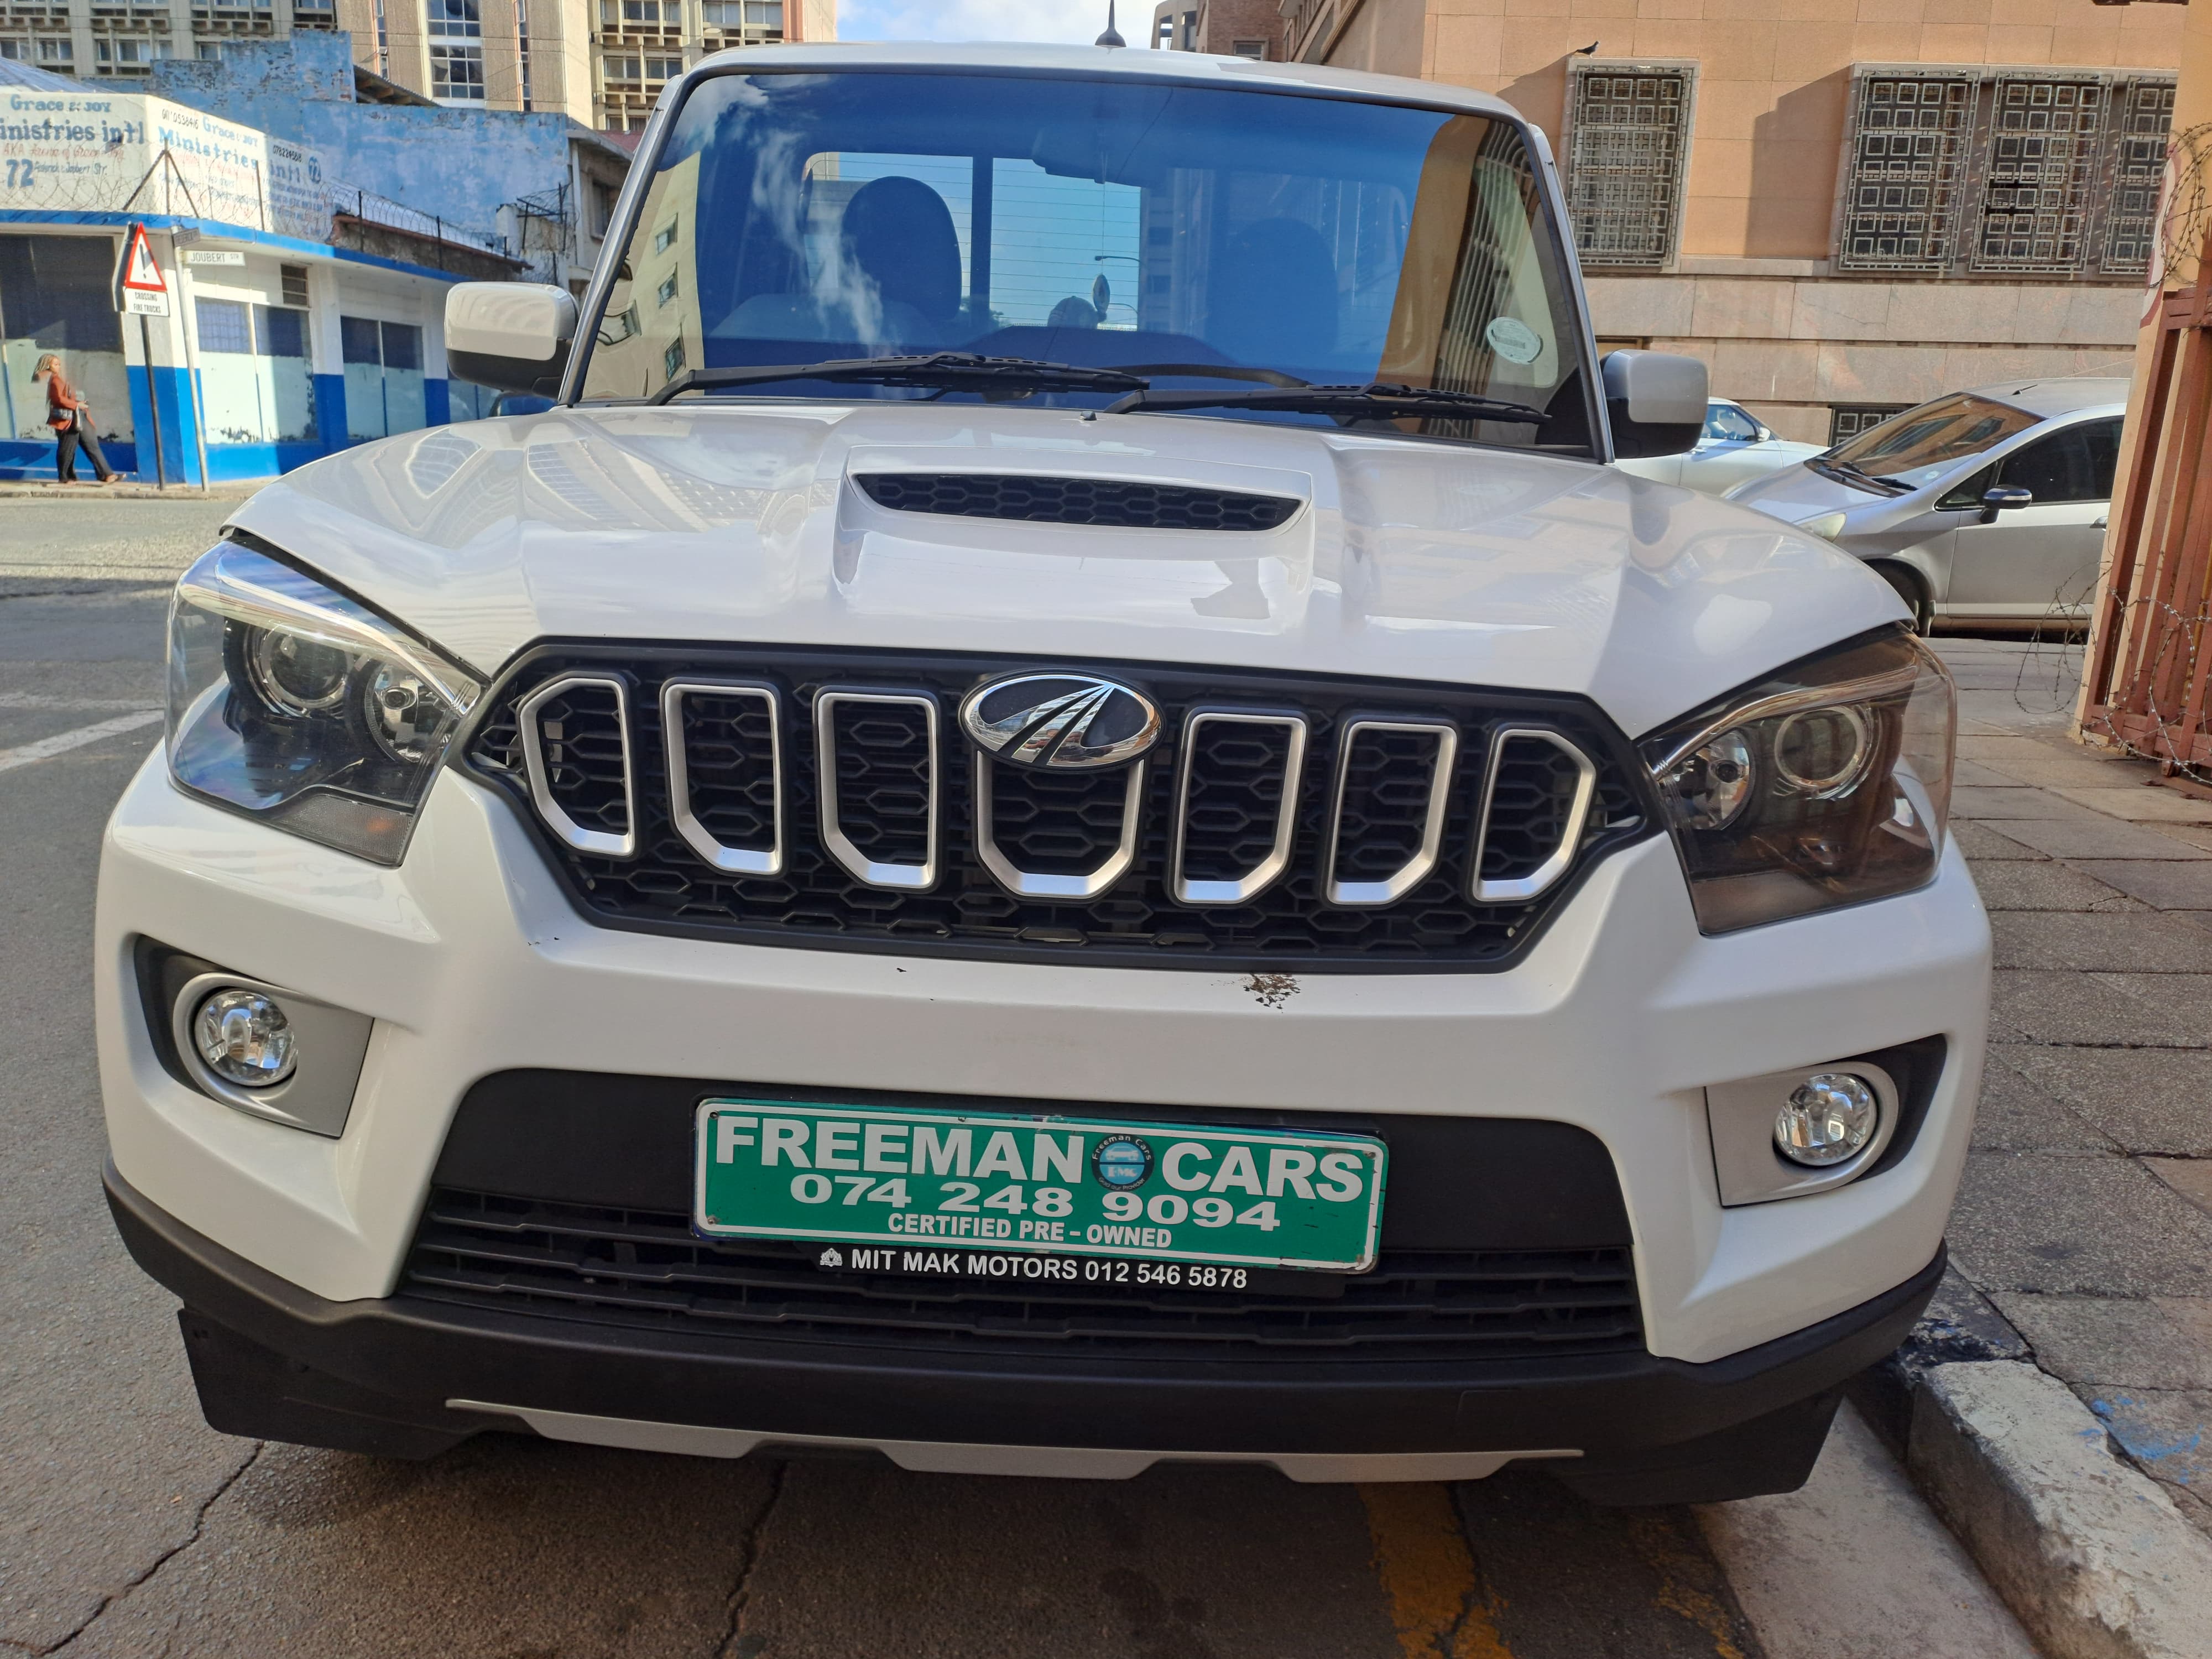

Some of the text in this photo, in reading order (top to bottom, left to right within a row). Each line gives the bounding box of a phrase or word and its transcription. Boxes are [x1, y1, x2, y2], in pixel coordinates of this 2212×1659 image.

[10, 94, 64, 112] Grace
[4, 143, 24, 156] AKA
[6, 158, 35, 189] 72
[191, 252, 225, 263] JOUBERT
[716, 1114, 1363, 1202] FREEMAN CARS
[1092, 1135, 1152, 1161] Freeman Cars
[790, 1173, 1281, 1232] 074 248 9094
[888, 1212, 1011, 1239] CERTIFIED
[1019, 1220, 1065, 1241] PRE
[1086, 1224, 1172, 1248] OWNED
[852, 1248, 1248, 1289] MIT MAK MOTORS 012 546 5878
